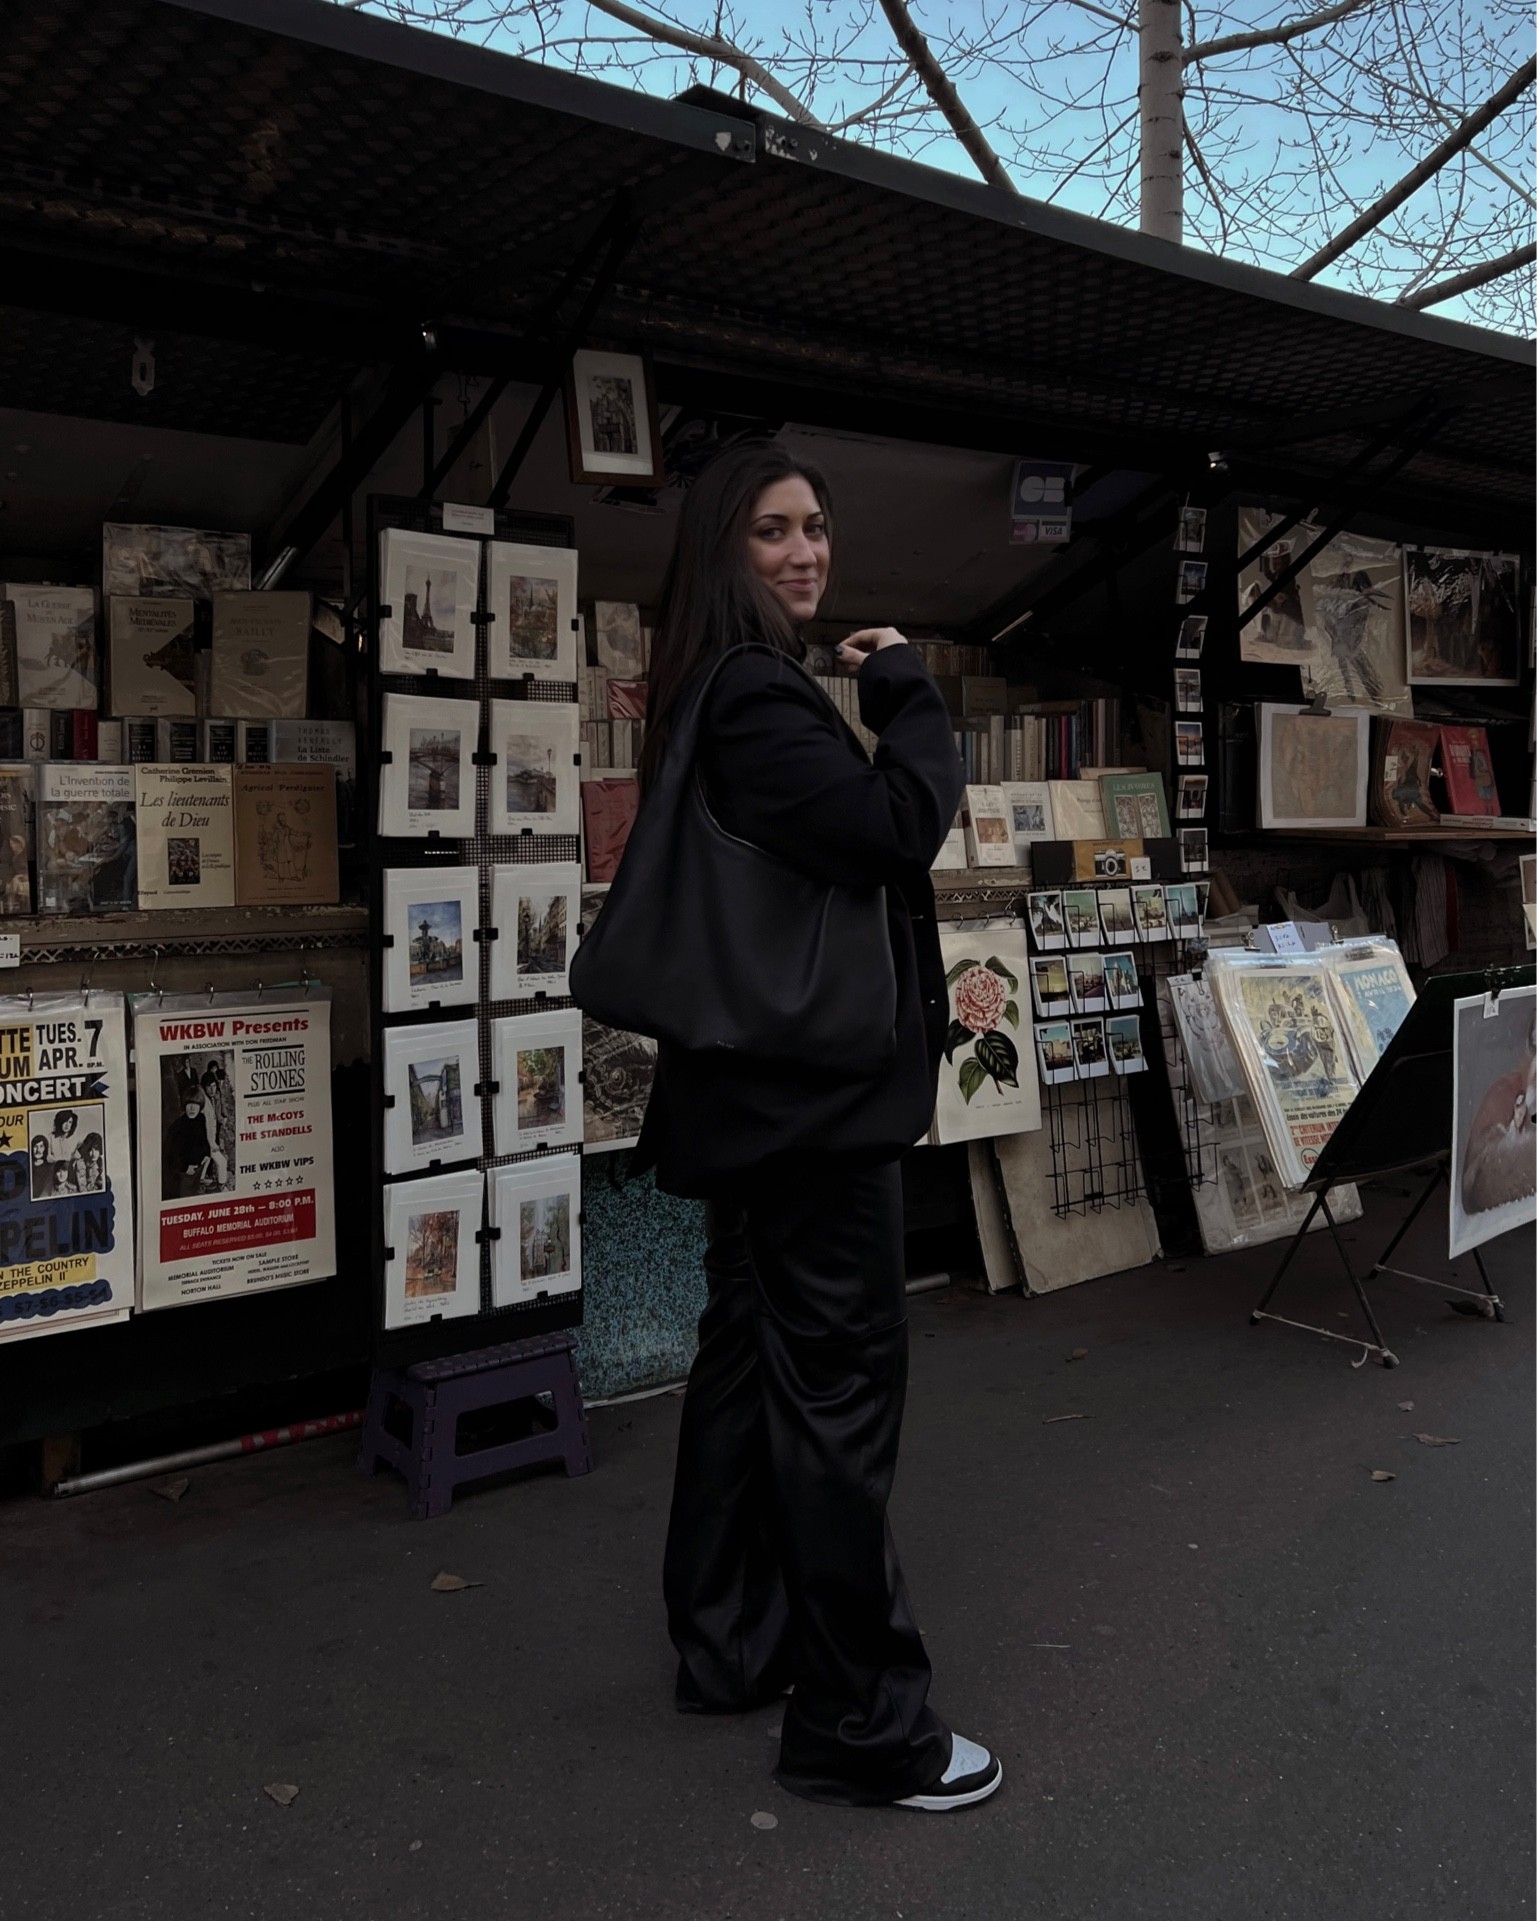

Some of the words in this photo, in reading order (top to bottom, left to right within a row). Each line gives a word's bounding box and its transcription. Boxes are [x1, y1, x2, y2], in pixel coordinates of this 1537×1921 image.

[1045, 526, 1062, 535] VISA
[297, 745, 307, 753] La
[310, 745, 331, 753] Liste
[297, 754, 308, 762] de
[310, 754, 350, 762] Schindler
[141, 767, 180, 775] Catherine
[60, 775, 115, 786] L'Invention
[117, 776, 130, 786] de
[160, 775, 193, 784] Philippe
[51, 787, 61, 798] la
[63, 790, 99, 799] guerre
[101, 787, 130, 798] totale
[140, 792, 165, 808] Les
[167, 791, 230, 807] lieutenants
[161, 811, 176, 828] de
[178, 812, 210, 828] Dieu
[1353, 969, 1398, 991] MONACO
[159, 1021, 225, 1042] WKBW
[232, 1018, 309, 1036] Presents
[36, 1022, 82, 1045] TUES.
[84, 1019, 103, 1058] 7
[191, 1041, 230, 1050] ASSOCIATION
[39, 1047, 84, 1071] APR.
[242, 1056, 254, 1066] THE
[255, 1050, 306, 1070] ROLLING
[250, 1068, 306, 1092] STONES
[0, 1077, 87, 1105] NCERT
[247, 1114, 264, 1125] THE
[267, 1110, 304, 1122] McCOYS
[240, 1131, 257, 1142] THE
[260, 1125, 313, 1139] STANDELLS
[271, 1145, 285, 1153] ALSO
[239, 1164, 256, 1174] THE
[259, 1159, 291, 1172] WKBW
[293, 1156, 314, 1167] VIPS
[161, 1211, 205, 1227] TUESDAY,
[207, 1207, 232, 1220] JUNE
[233, 1204, 255, 1216] 28th
[268, 1199, 292, 1210] 8:00
[294, 1195, 315, 1206] P.M.
[183, 1225, 215, 1239] BUFFALO
[216, 1219, 252, 1233] MEMORIAL
[254, 1213, 294, 1228] AUDITORIUM
[179, 1243, 191, 1251] ALL
[191, 1241, 212, 1250] SEATS
[213, 1235, 247, 1247] RESERVED
[11, 1266, 32, 1279] THE
[37, 1257, 90, 1274] COUNTRY
[212, 1257, 231, 1265] TICKETS
[231, 1255, 245, 1263] NOW
[258, 1257, 280, 1266] SAMPLE
[282, 1254, 299, 1263] STORE
[168, 1271, 199, 1281] MEMORIAL
[200, 1265, 235, 1276] AUDITORIUM
[275, 1271, 292, 1280] MUSIC
[293, 1268, 310, 1277] STORE
[181, 1285, 207, 1296] NORTON
[207, 1283, 222, 1292] HALL
